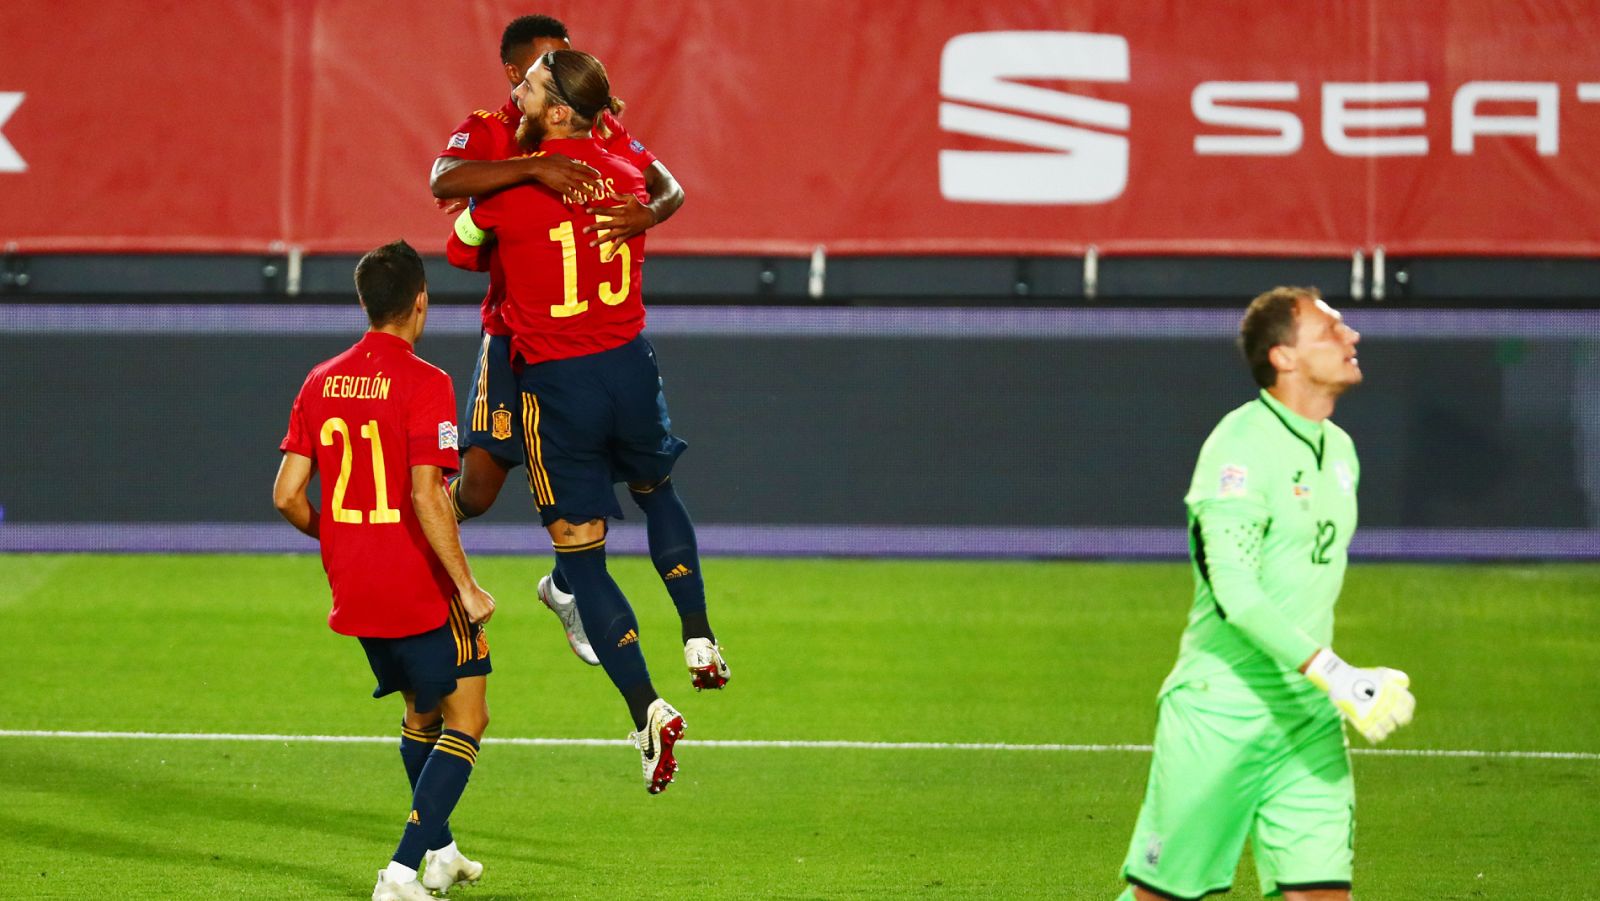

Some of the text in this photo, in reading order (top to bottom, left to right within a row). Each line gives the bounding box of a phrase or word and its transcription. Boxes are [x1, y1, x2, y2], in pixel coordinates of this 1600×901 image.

[1191, 81, 1600, 156] SEA
[549, 205, 631, 318] 15
[322, 371, 391, 400] REGUILÓN
[320, 417, 400, 524] 21
[1311, 520, 1336, 564] 12
